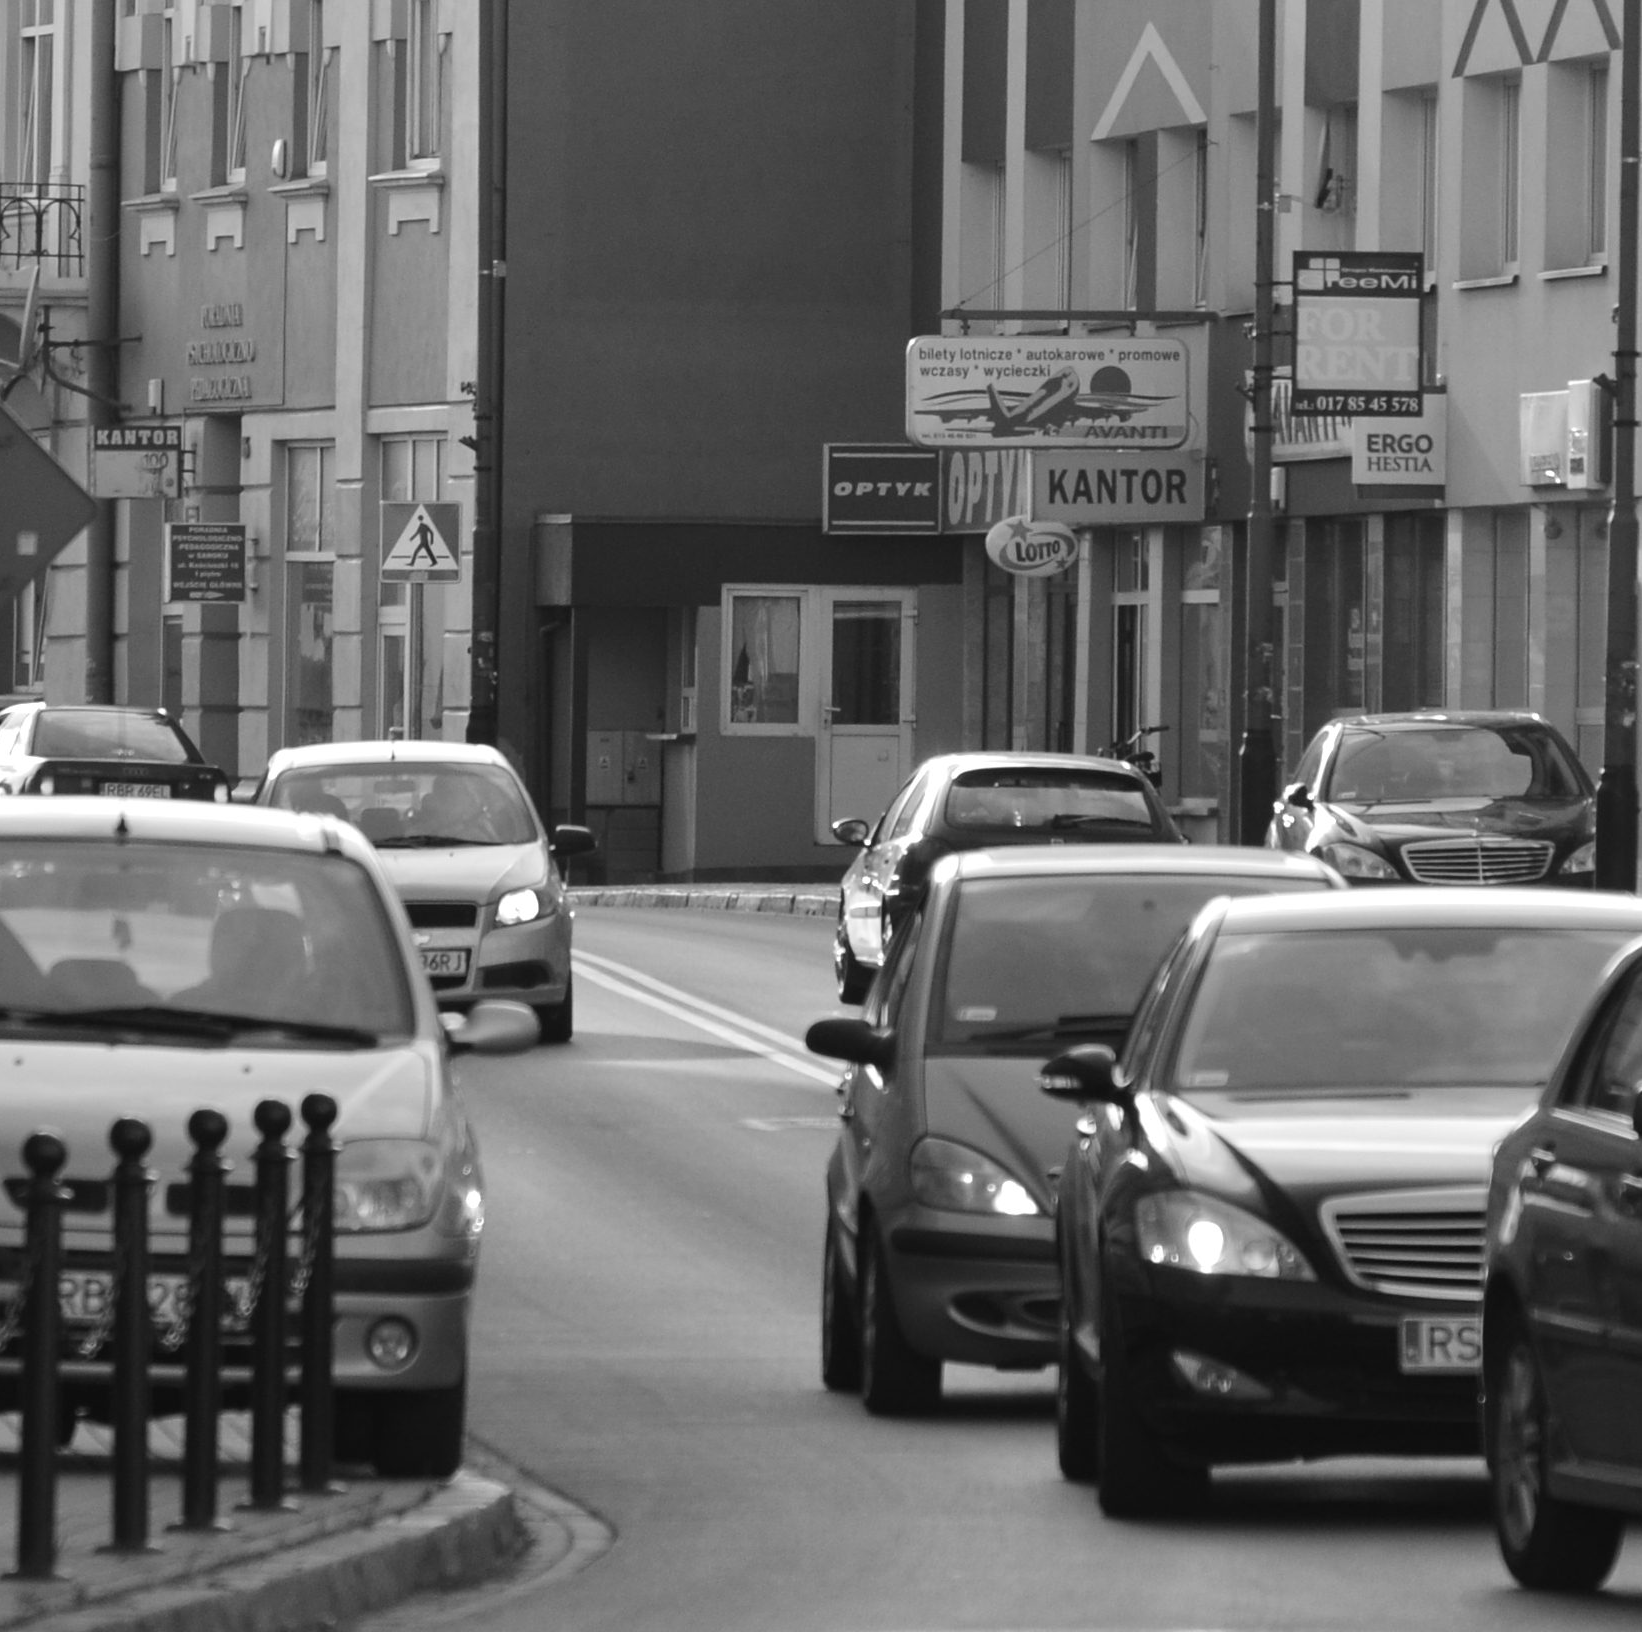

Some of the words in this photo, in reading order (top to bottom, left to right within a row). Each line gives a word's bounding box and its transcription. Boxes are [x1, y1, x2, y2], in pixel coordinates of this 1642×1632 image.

[1297, 307, 1385, 341] FOR
[919, 348, 956, 363] bilety
[960, 348, 1013, 361] lotnicze
[1026, 348, 1105, 361] autokarowe
[1119, 350, 1180, 364] promowe
[1297, 345, 1419, 381] RENT
[920, 366, 969, 379] wczasy
[984, 364, 1051, 379] wycieczki
[1316, 395, 1344, 411] 017
[1347, 396, 1366, 411] 85
[1369, 396, 1387, 412] 45
[1391, 396, 1419, 412] 578
[96, 429, 179, 445] KANTOR
[1084, 425, 1168, 439] AVANTI
[1366, 433, 1433, 454] ERGO
[1367, 456, 1433, 472] HESTIA
[834, 481, 933, 497] OPTYK
[1048, 469, 1188, 504] KANTOR
[1015, 540, 1061, 562] LOTTO
